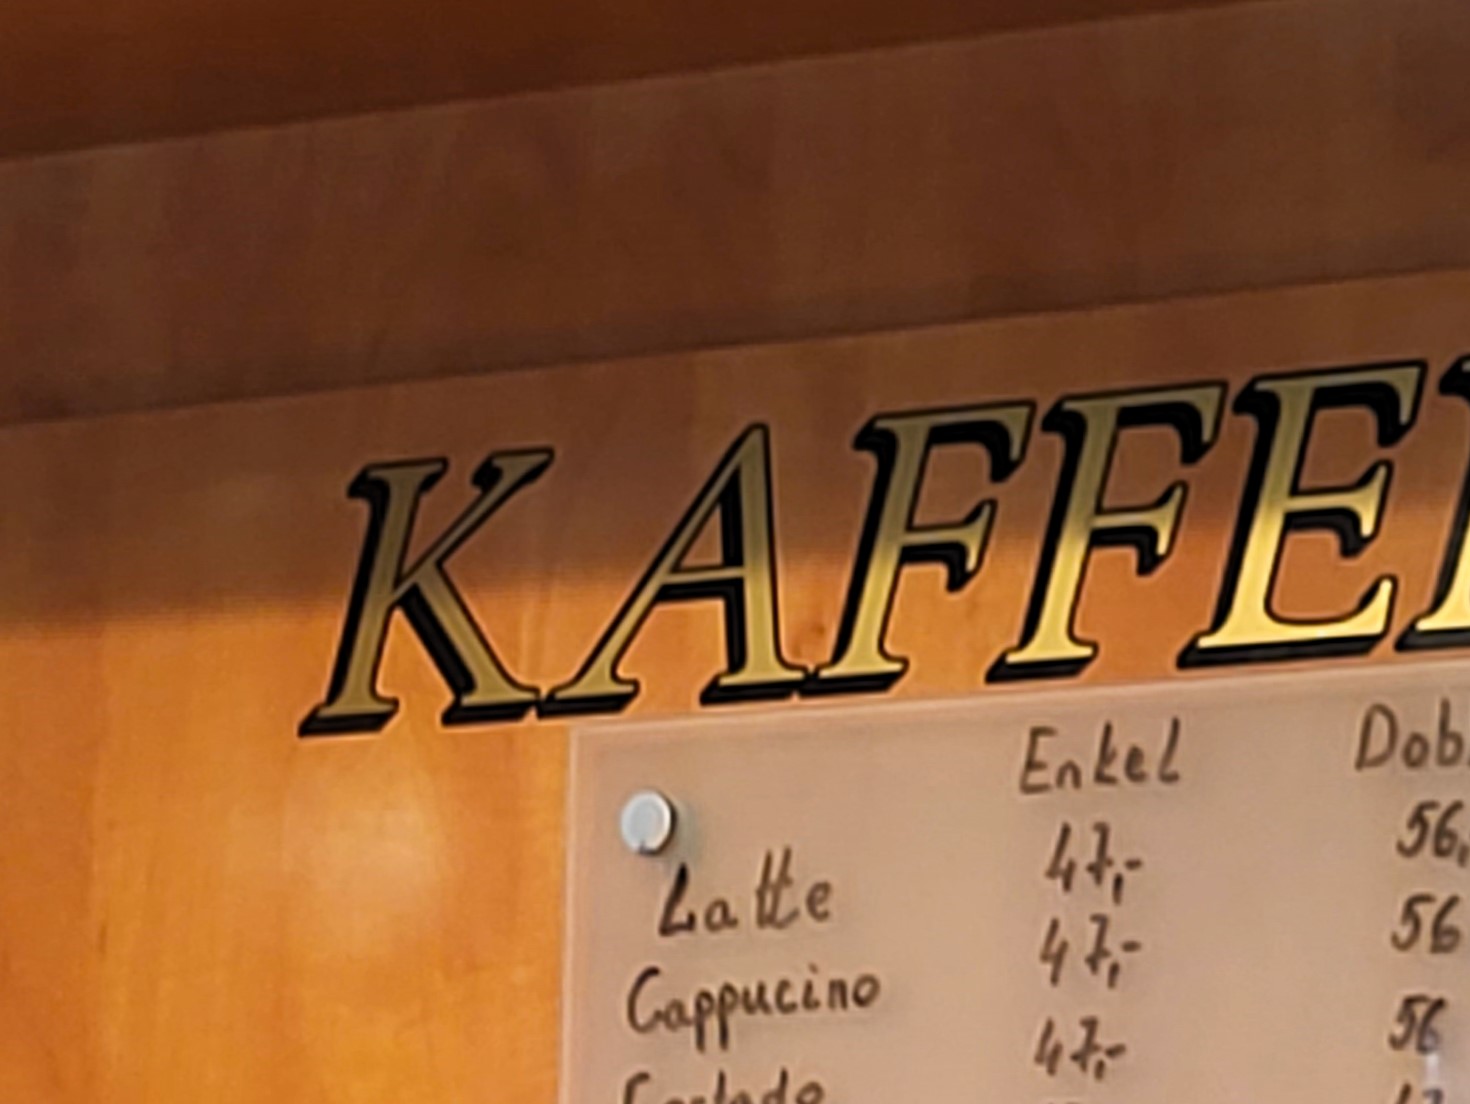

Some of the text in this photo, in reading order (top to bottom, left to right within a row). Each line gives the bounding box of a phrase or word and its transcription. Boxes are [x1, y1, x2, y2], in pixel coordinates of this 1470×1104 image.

[1018, 717, 1183, 794] Enkel
[658, 846, 833, 938] Latte
[1045, 821, 1143, 904] 47,-
[626, 894, 1461, 1054] Cappucino 47,- 56
[1033, 1016, 1127, 1081] 47,-
[1388, 994, 1447, 1056] 56
